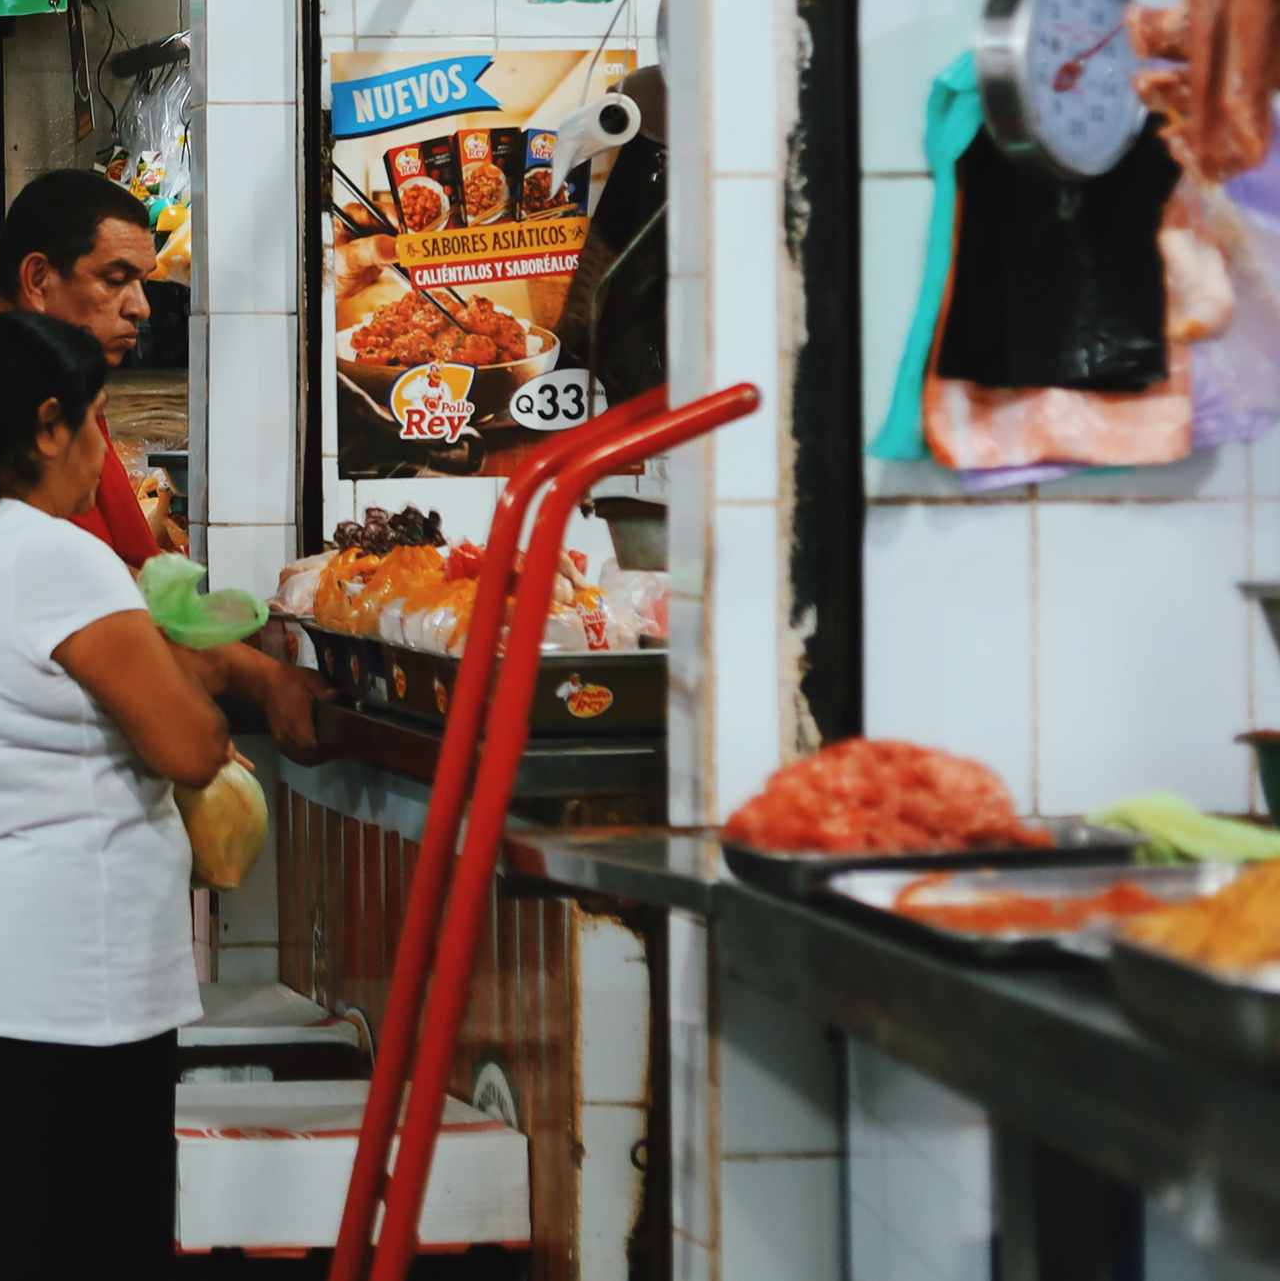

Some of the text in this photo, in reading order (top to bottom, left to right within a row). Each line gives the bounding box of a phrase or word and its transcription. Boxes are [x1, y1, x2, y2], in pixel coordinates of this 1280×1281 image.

[352, 63, 468, 124] NUEVOS
[421, 223, 567, 258] SABORES ASIÁTICOS
[414, 251, 579, 287] CALIÉNTALOS Y SABORÉALOS
[441, 400, 474, 414] Pollo
[403, 408, 468, 442] Rey
